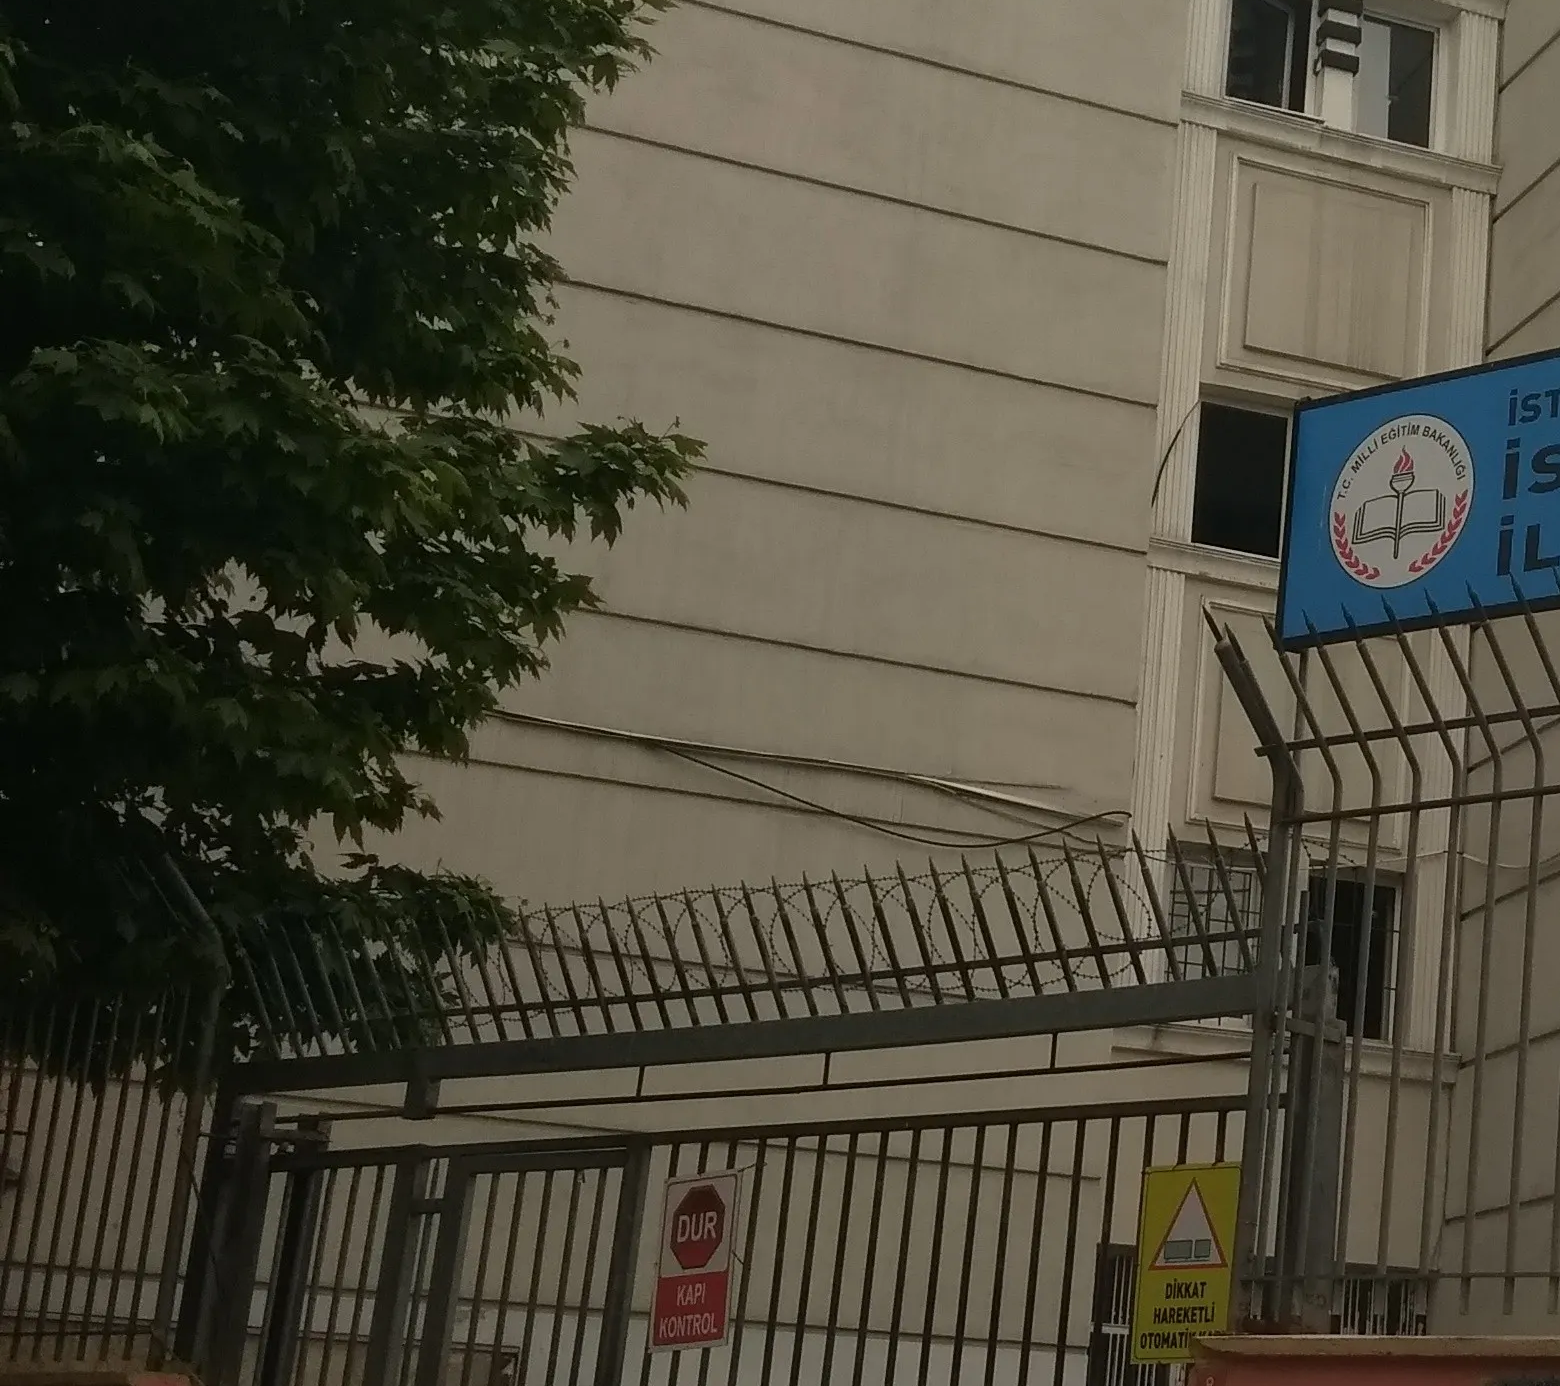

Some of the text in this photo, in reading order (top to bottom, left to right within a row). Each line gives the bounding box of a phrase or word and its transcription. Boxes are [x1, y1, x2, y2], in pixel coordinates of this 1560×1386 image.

[1337, 476, 1354, 500] T.C.
[1381, 422, 1420, 446] EĞİTİM
[1422, 425, 1466, 481] BAKANLIĞI
[676, 1211, 718, 1244] DUR
[676, 1282, 706, 1307] KAPI
[1165, 1278, 1207, 1301] DİKKAT
[659, 1312, 718, 1339] KONTROL
[1153, 1301, 1215, 1325] HAREKETLİ
